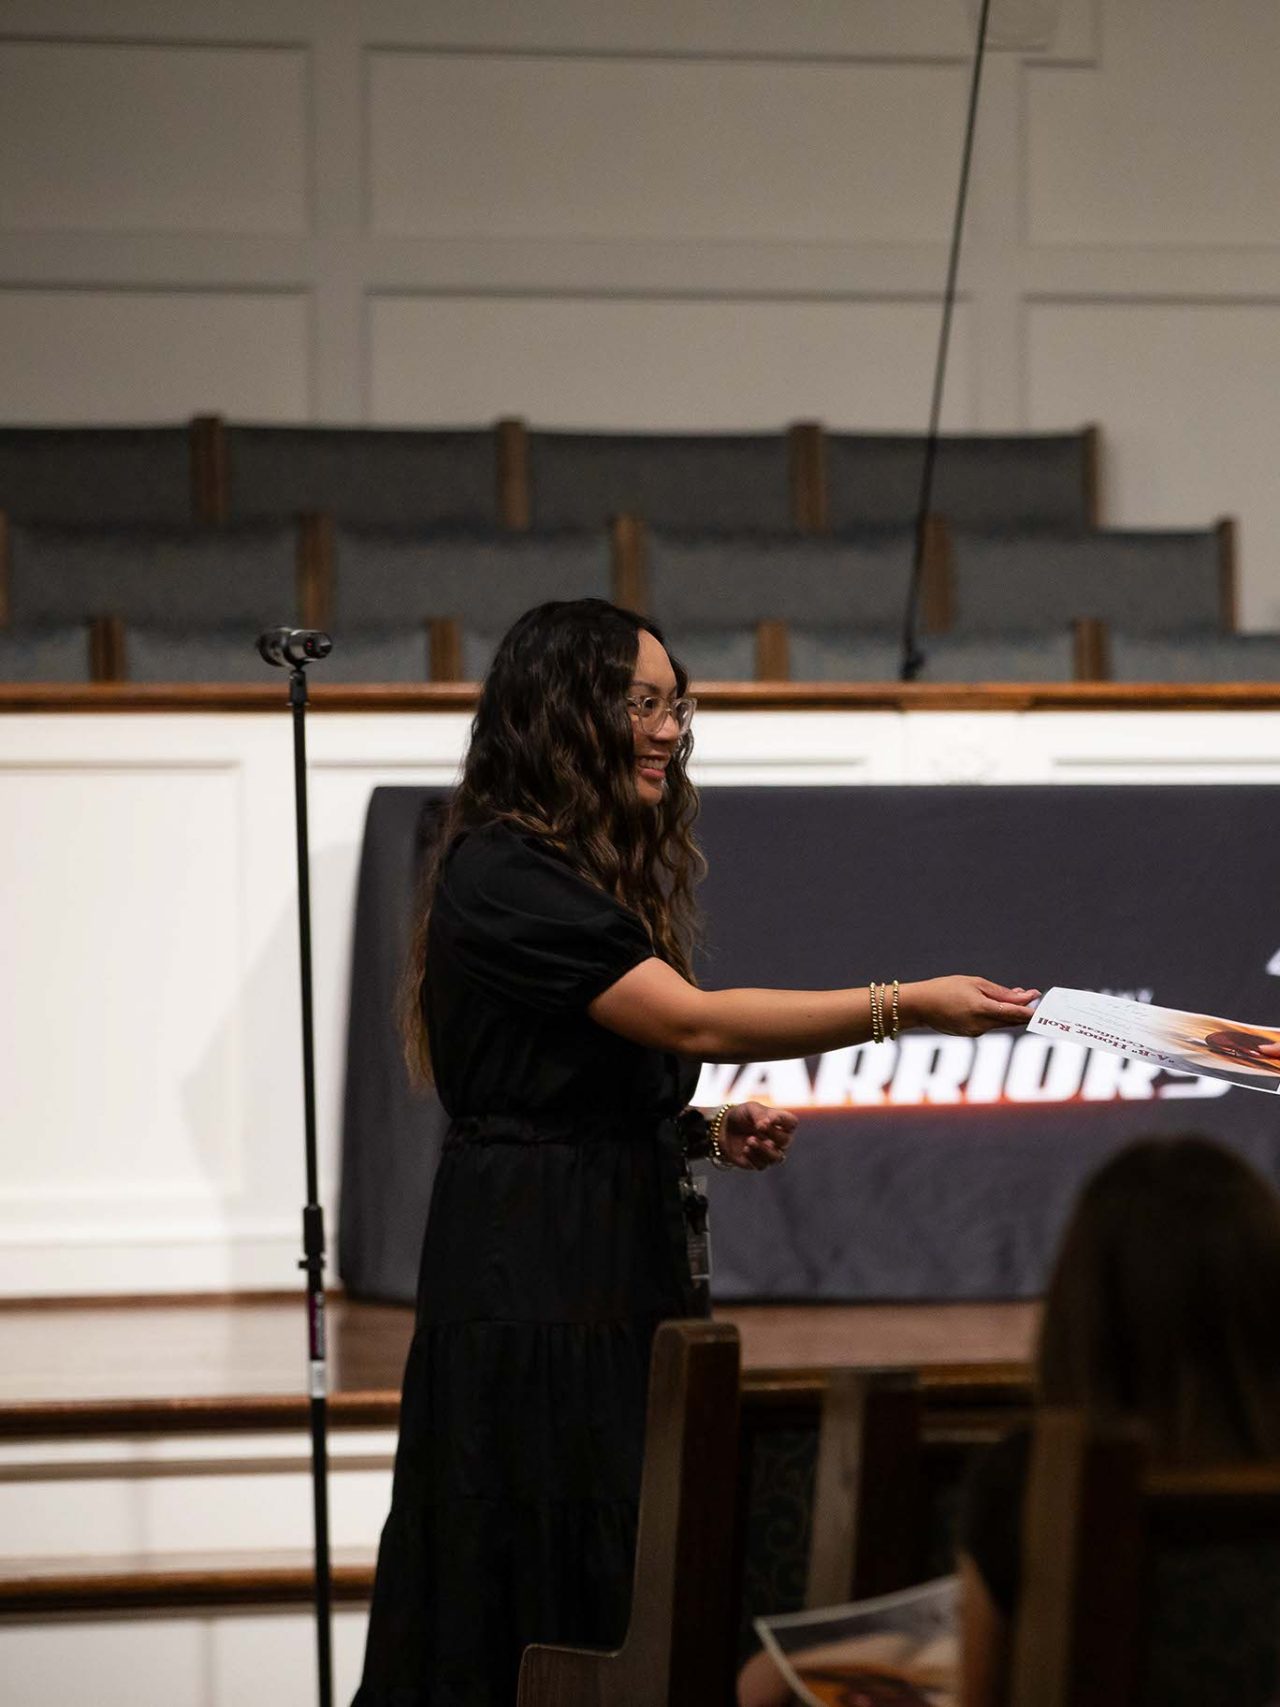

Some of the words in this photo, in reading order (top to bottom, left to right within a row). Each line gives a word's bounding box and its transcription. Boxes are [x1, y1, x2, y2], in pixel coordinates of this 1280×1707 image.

[1037, 1017, 1071, 1032] Roll
[1074, 1022, 1145, 1049] Certificate
[1075, 1030, 1127, 1050] Honor
